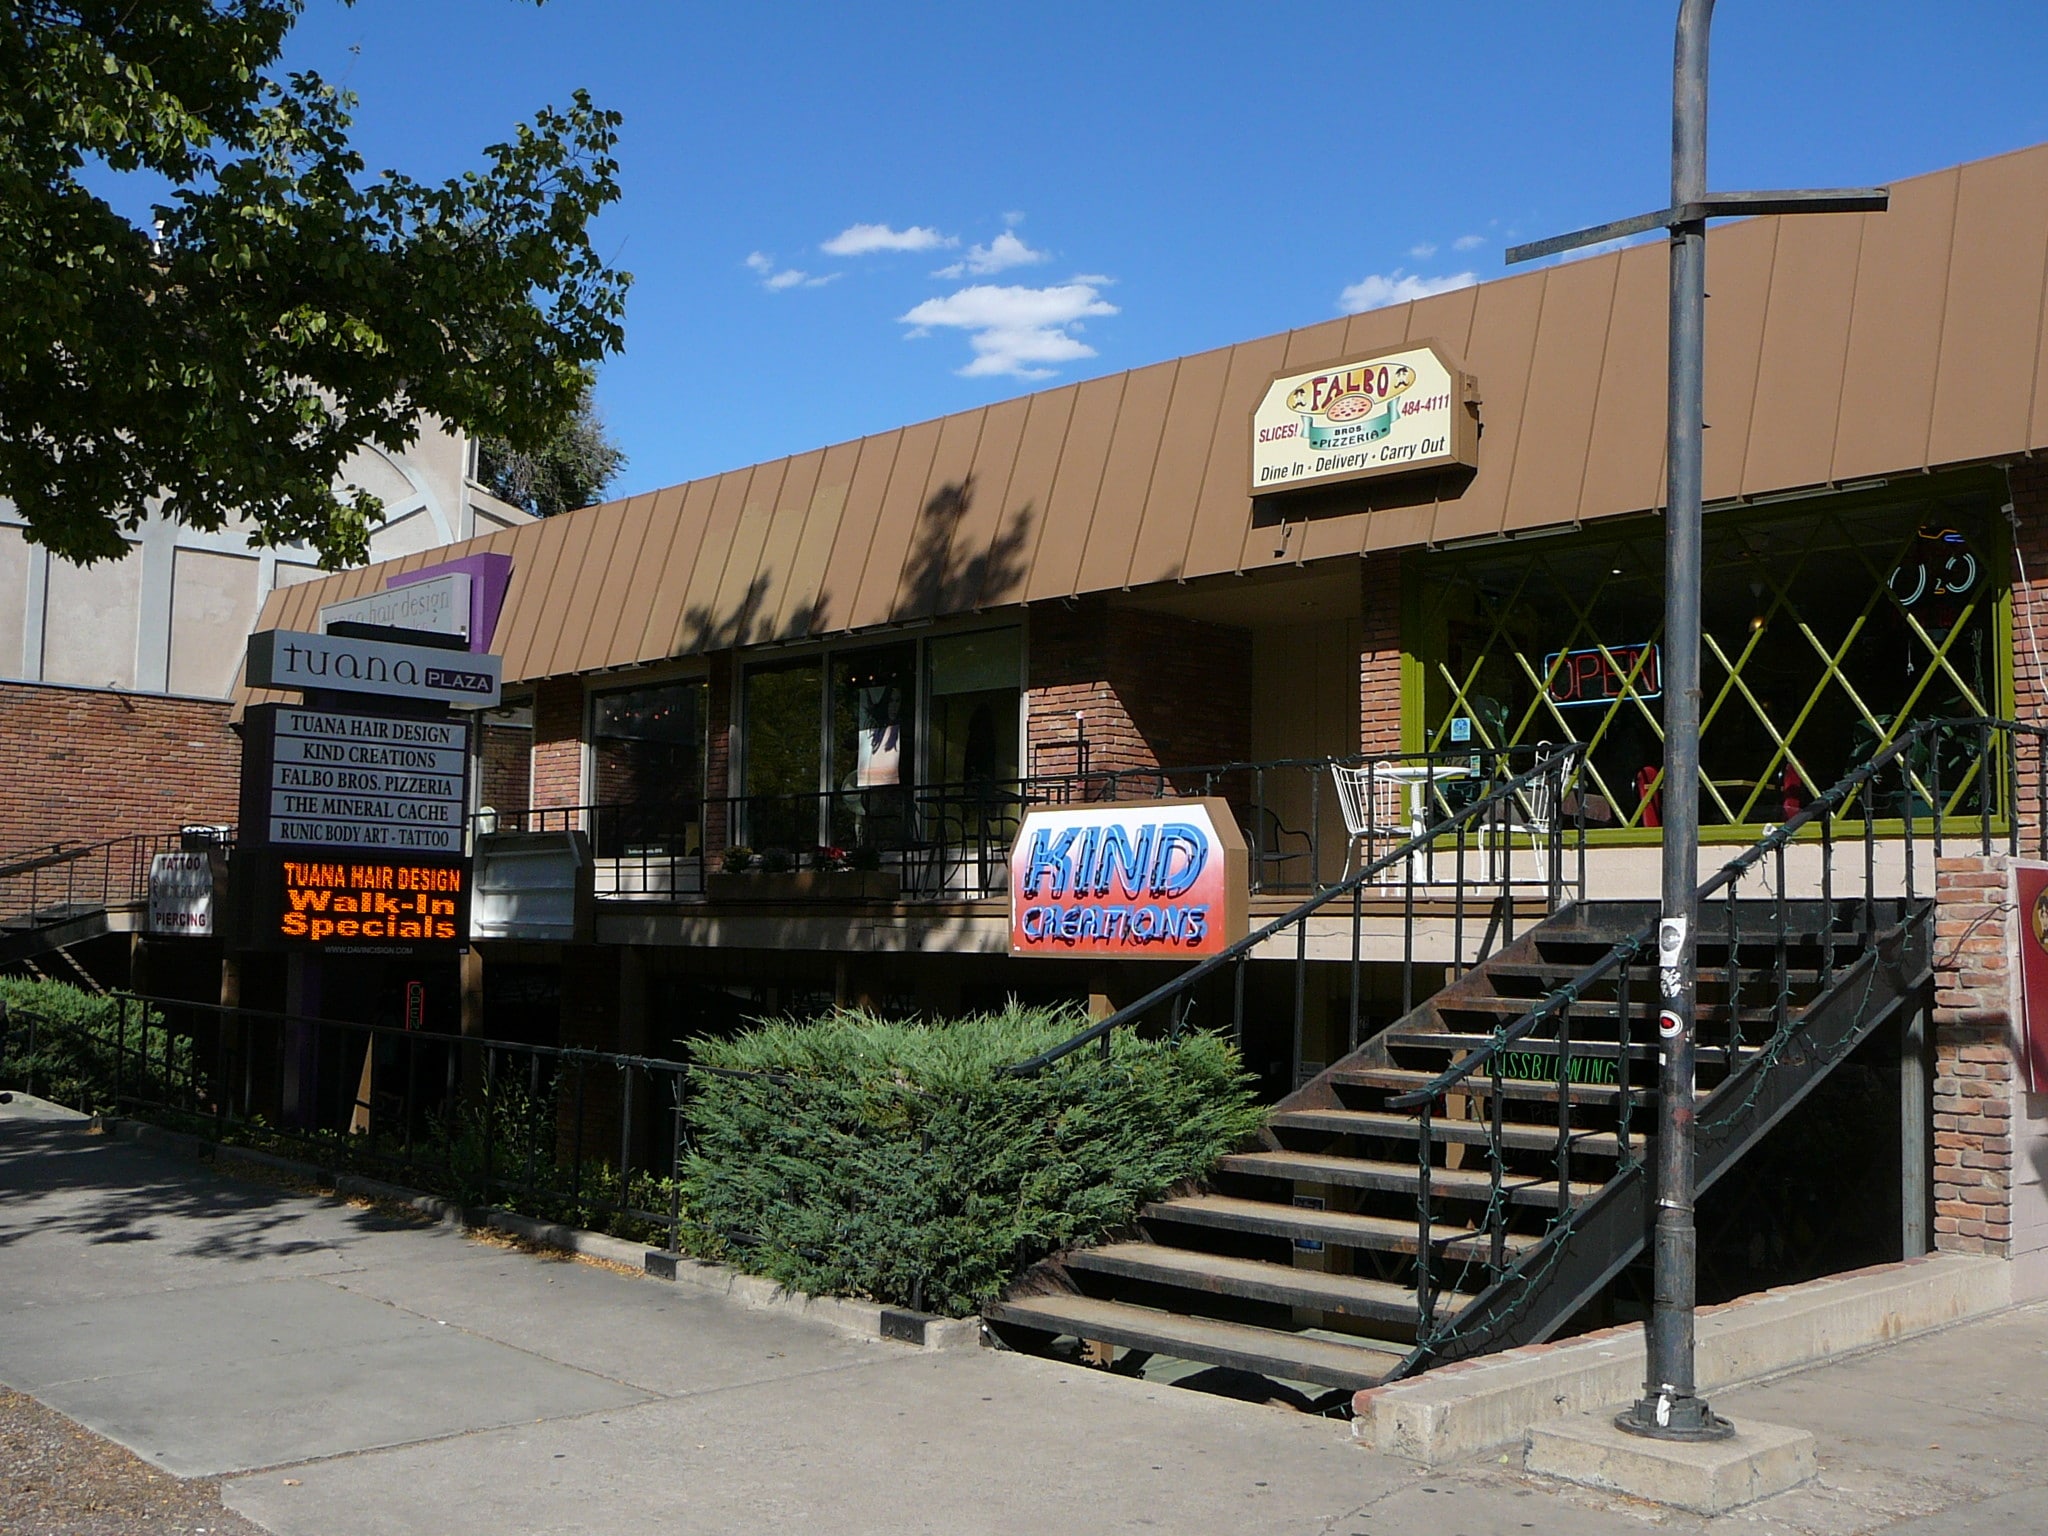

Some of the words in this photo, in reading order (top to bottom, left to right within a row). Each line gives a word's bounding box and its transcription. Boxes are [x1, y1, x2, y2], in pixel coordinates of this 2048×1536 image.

[1311, 366, 1388, 411] FALBO
[1402, 393, 1450, 416] 484-4111
[1259, 423, 1298, 443] SLICES!
[1319, 430, 1380, 448] PIZZERIA
[1261, 465, 1288, 481] Dine
[1292, 461, 1303, 477] In
[1315, 451, 1368, 472] Delivery
[1380, 443, 1418, 462] Carry
[1421, 435, 1445, 454] Out
[401, 585, 450, 623] design
[283, 642, 420, 686] tuana
[428, 671, 490, 691] PLAZA
[1550, 647, 1656, 700] OPEN
[291, 714, 346, 736] TUANA
[350, 719, 389, 739] HAIR
[392, 724, 451, 744] DESIGN
[303, 742, 344, 761] KIND
[349, 746, 437, 768] CREATIONS
[281, 768, 334, 788] FALBO
[337, 772, 381, 791] BROS.
[384, 775, 452, 796] PIZZERIA
[284, 795, 318, 813] THE
[321, 798, 394, 819] MINERAL
[397, 802, 449, 822] CACHE
[281, 822, 323, 841] RUNIC
[325, 825, 361, 843] BODY
[363, 827, 389, 844] ART
[399, 829, 449, 847] TATTOO
[160, 857, 201, 870] TATTOO
[1024, 823, 1208, 898] KIND
[283, 862, 346, 888] TUANA
[351, 865, 393, 890] HAIR
[398, 867, 460, 892] DESIGN
[287, 889, 455, 915] Walk-In
[156, 912, 206, 926] PIERCING
[281, 911, 456, 941] Specials
[1022, 904, 1210, 945] CREATIONS
